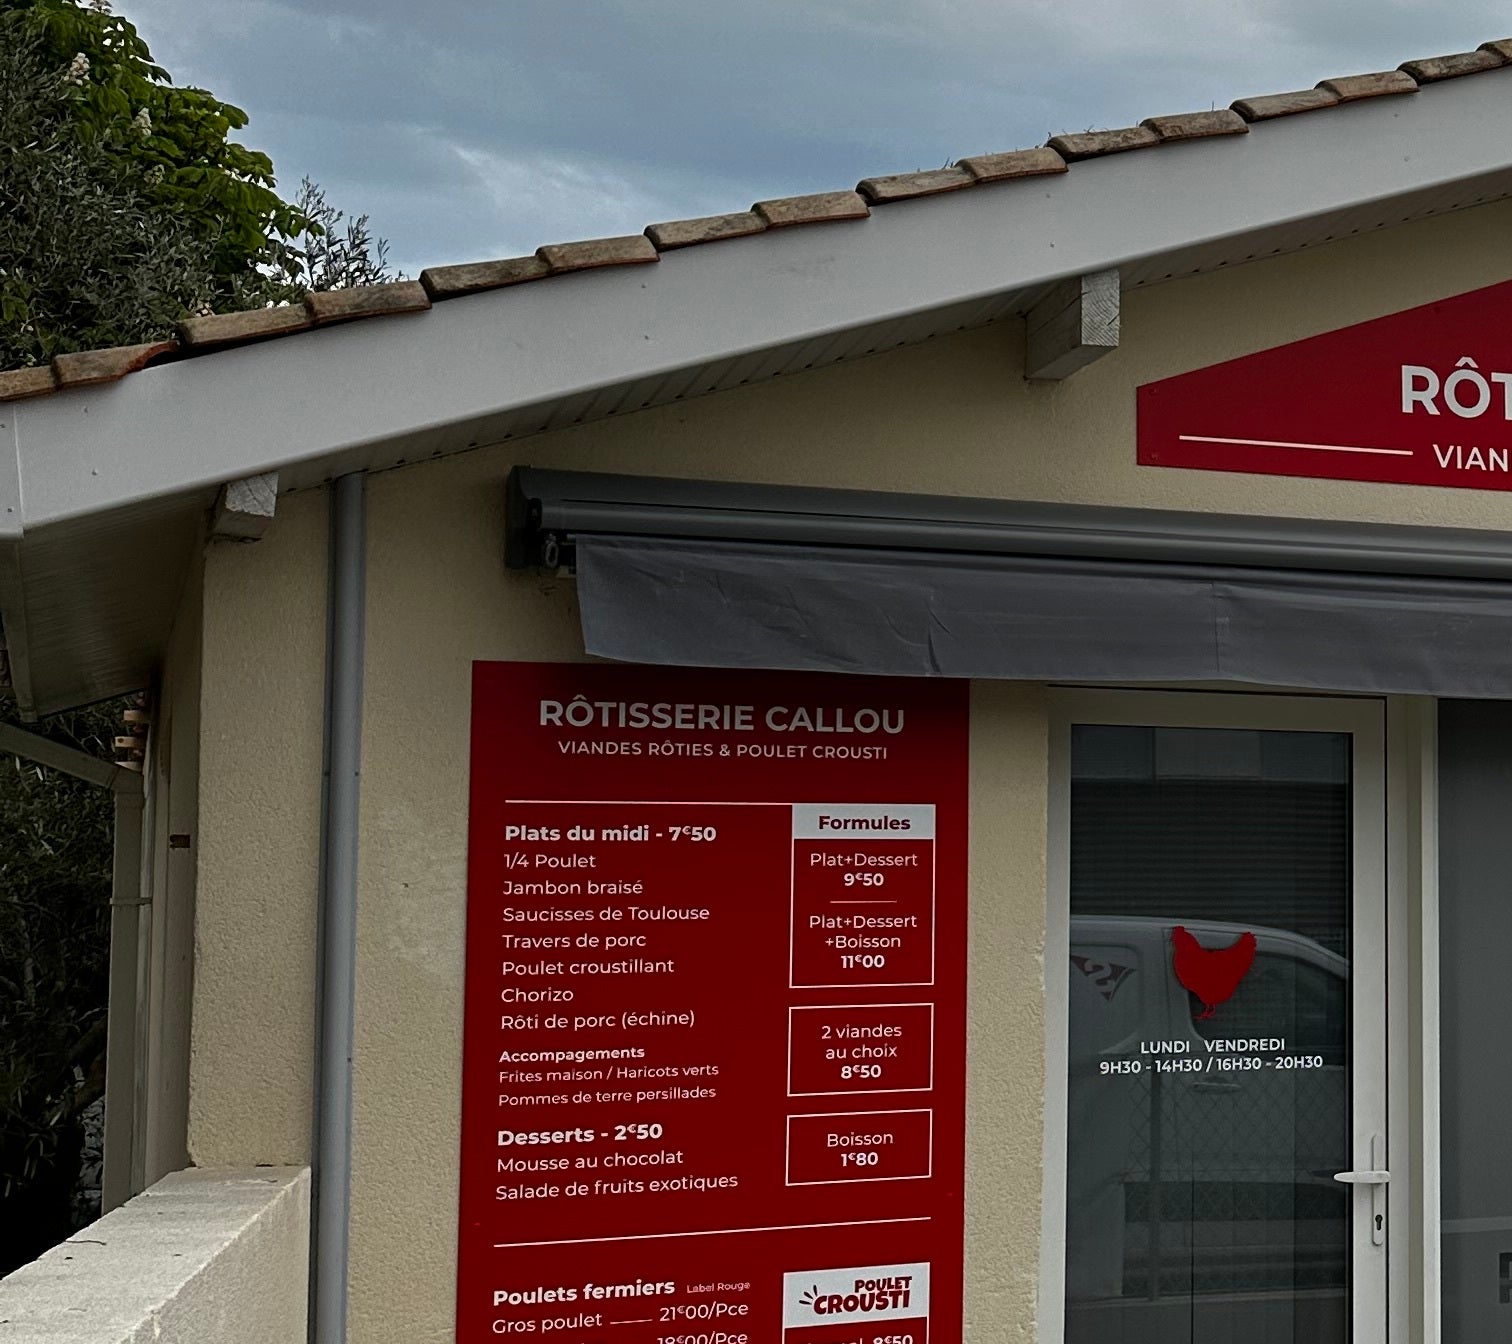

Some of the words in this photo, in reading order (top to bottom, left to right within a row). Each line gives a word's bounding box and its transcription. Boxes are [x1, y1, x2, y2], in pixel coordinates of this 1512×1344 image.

[539, 694, 755, 731] RÔTISSERIE
[765, 706, 905, 734] CALLOU
[557, 740, 642, 756] VIANDES
[648, 739, 714, 757] RÔTIES
[718, 743, 731, 757] &
[736, 744, 808, 758] POULET
[812, 745, 887, 760] CROUSTI
[818, 815, 911, 831] Formules
[505, 824, 561, 841] Plats
[566, 825, 595, 841] du
[601, 824, 650, 842] midi
[503, 851, 530, 870] 1/4
[535, 853, 597, 868] Poulet
[810, 852, 918, 867] Plat+Dessert
[502, 879, 581, 896] Jambon
[587, 879, 644, 895] braisé
[502, 906, 595, 922] Saucisses
[599, 906, 623, 921] de
[627, 905, 710, 921] Toulouse
[809, 914, 918, 929] Plat+Dessert
[501, 934, 571, 949] Travers
[575, 932, 600, 948] de
[605, 935, 647, 951] porc
[824, 933, 901, 949] +Boisson
[502, 960, 565, 976] Poulet
[569, 958, 675, 975] croustillant
[501, 986, 574, 1003] Chorizo
[501, 1013, 539, 1030] Rôti
[544, 1013, 569, 1029] de
[574, 1015, 616, 1032] porc
[621, 1009, 695, 1030] (échine)
[821, 1025, 832, 1040] 2
[835, 1023, 903, 1039] viandes
[825, 1048, 847, 1060] au
[851, 1043, 898, 1059] choix
[1140, 1040, 1190, 1054] LUNDI
[1203, 1038, 1285, 1053] VENDREDI
[498, 1047, 645, 1064] Accompagements
[499, 1070, 543, 1084] Frites
[546, 1070, 603, 1082] maison
[605, 1065, 614, 1081] /
[616, 1065, 679, 1079] Haricots
[681, 1064, 720, 1076] verts
[1099, 1060, 1142, 1075] 9H30
[1154, 1058, 1203, 1073] 14H30
[1205, 1056, 1214, 1073] /
[1215, 1056, 1262, 1071] 16H30
[1274, 1055, 1324, 1070] 20H30
[498, 1094, 569, 1107] Pommes
[572, 1090, 593, 1104] de
[595, 1091, 633, 1103] terre
[636, 1085, 717, 1104] persillades
[497, 1127, 595, 1146] Desserts
[827, 1131, 894, 1148] Boisson
[497, 1158, 570, 1173] Mousse
[574, 1156, 598, 1169] au
[603, 1149, 684, 1168] chocolat
[495, 1182, 560, 1201] Salade
[564, 1181, 589, 1197] de
[594, 1178, 645, 1195] fruits
[649, 1174, 739, 1193] exotiques
[493, 1286, 578, 1307] Poulets
[582, 1278, 676, 1300] fermiers
[855, 1276, 912, 1293] POULET
[814, 1290, 910, 1315] CROUSTI
[492, 1319, 536, 1334] Gros
[541, 1312, 603, 1334] poulet
